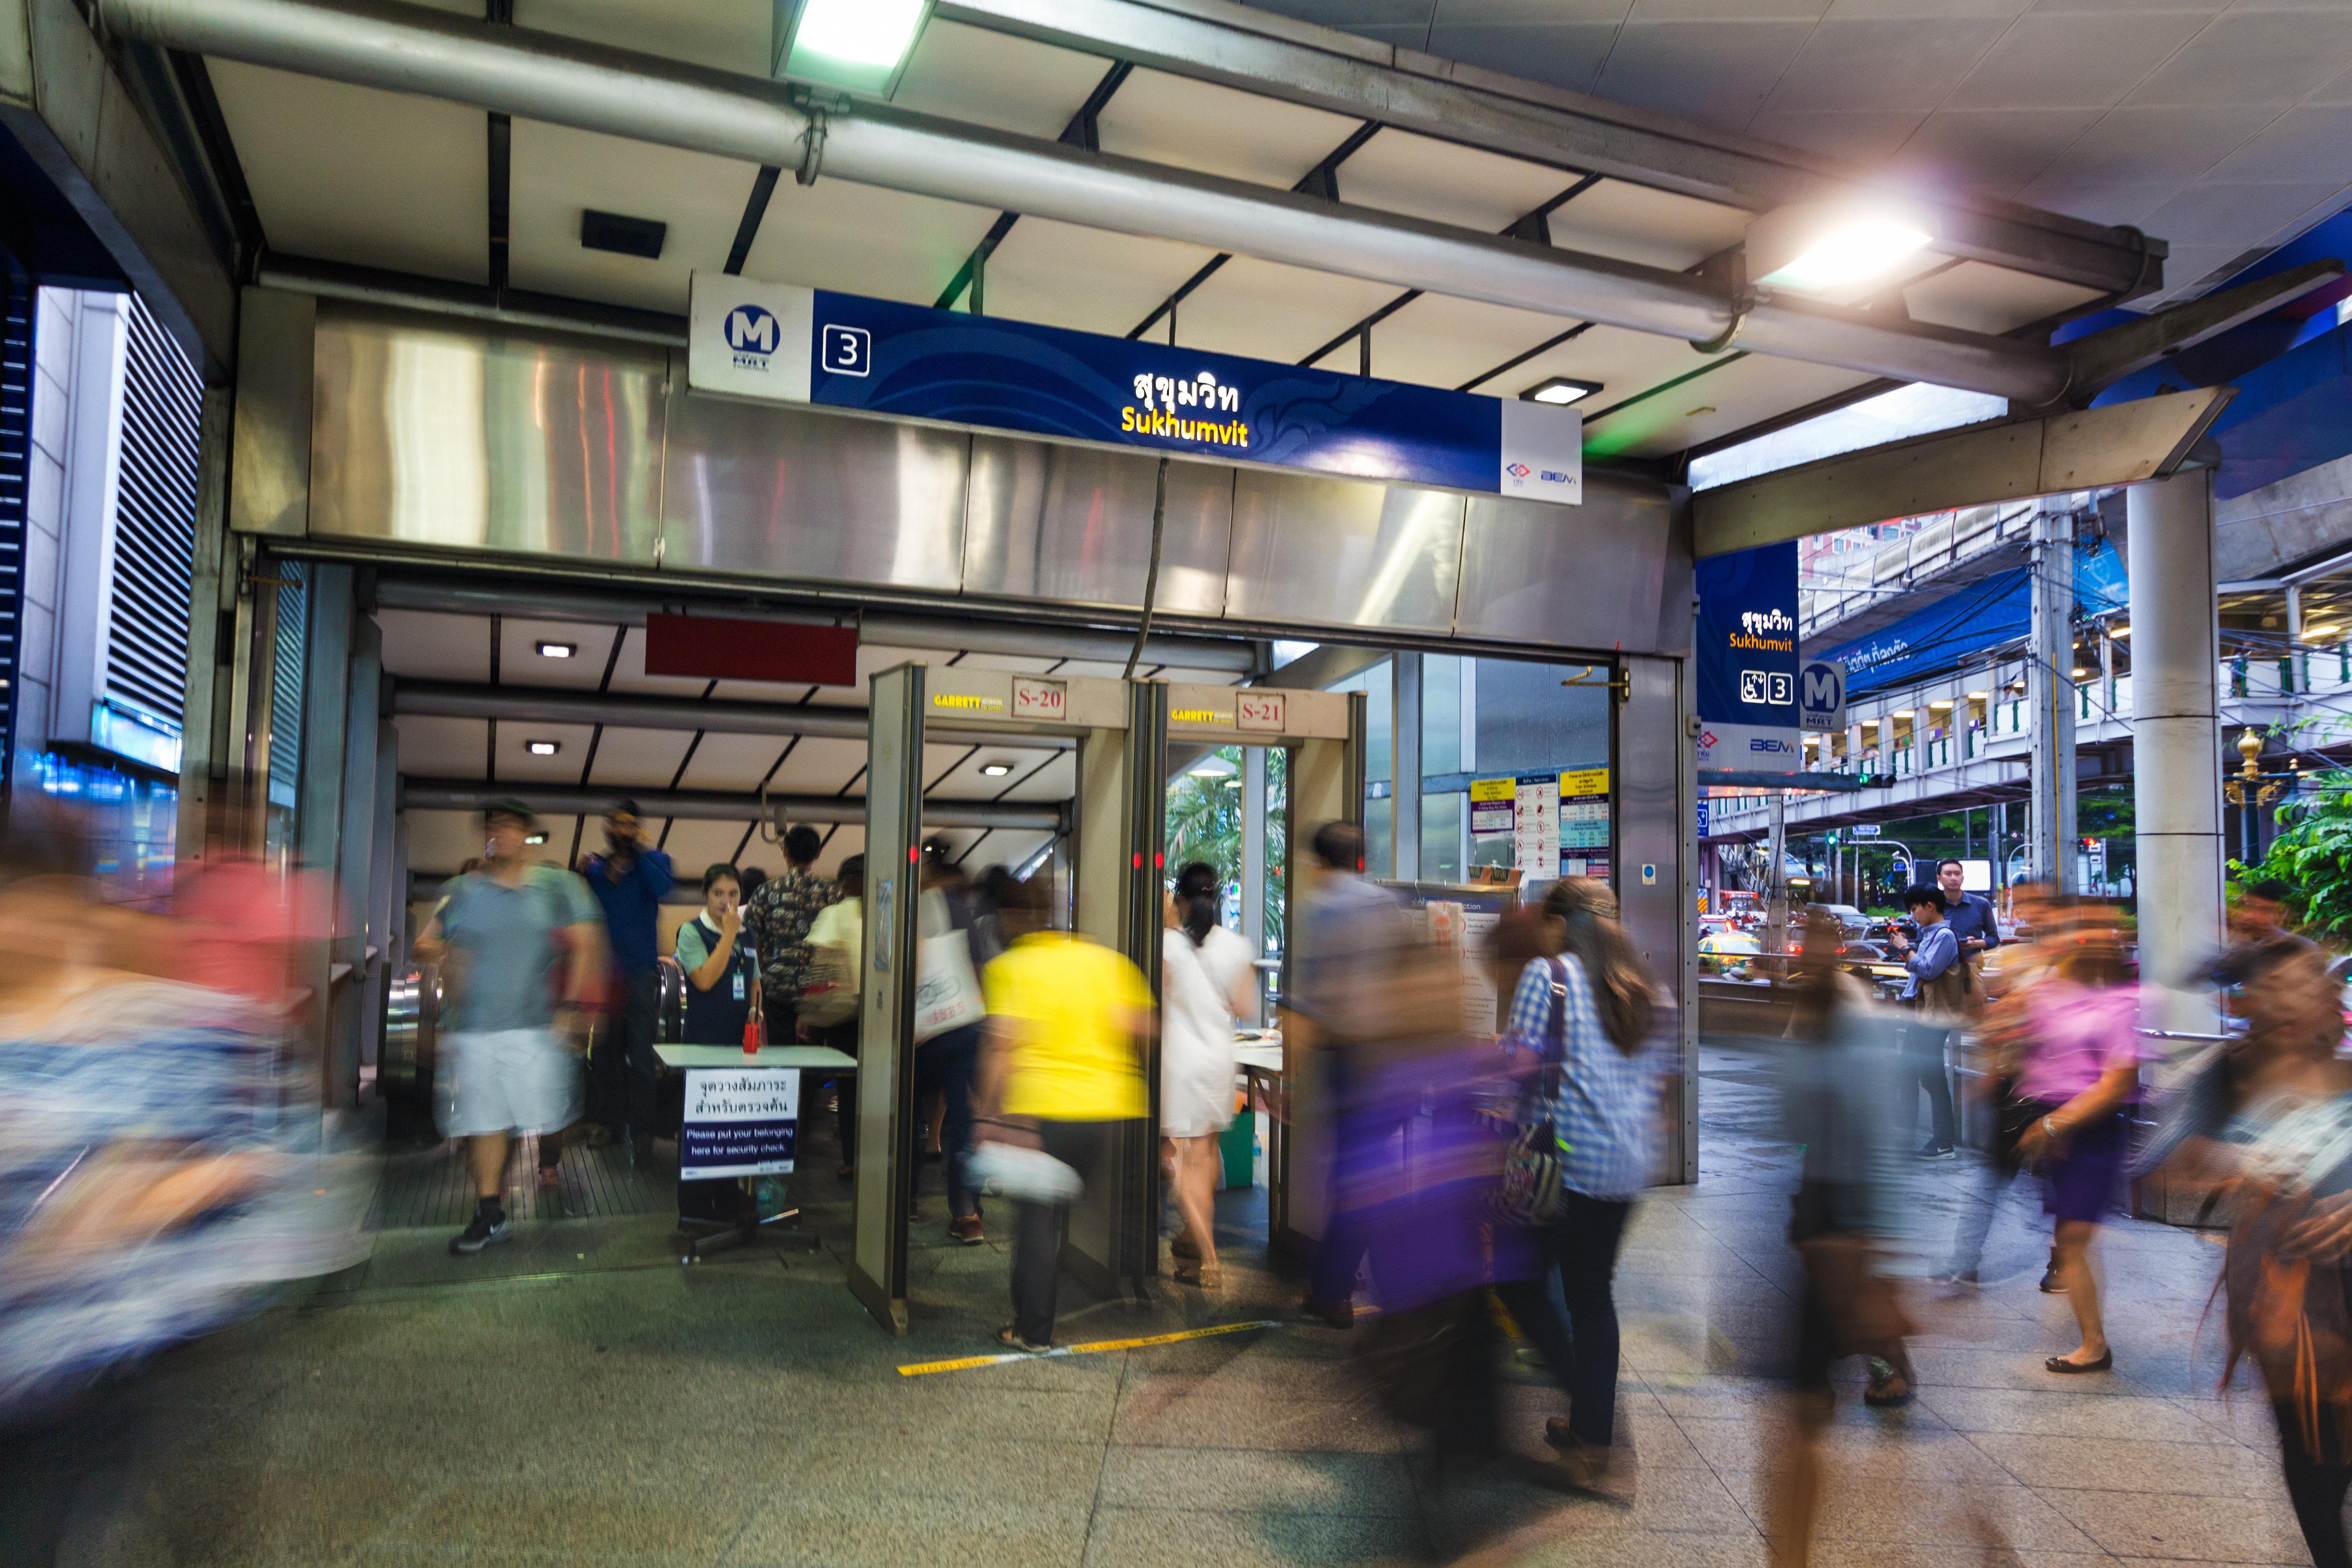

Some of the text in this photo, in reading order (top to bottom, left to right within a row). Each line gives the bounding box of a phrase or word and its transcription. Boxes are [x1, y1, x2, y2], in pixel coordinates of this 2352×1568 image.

[838, 334, 858, 365] 3
[1134, 372, 1238, 414] สุขุมวิท
[1122, 407, 1248, 447] Sukhumvit
[1741, 609, 1792, 634] สุขุมวิท
[1730, 633, 1792, 652] Sukhumvit
[1775, 679, 1785, 698] 3
[934, 694, 981, 709] GARRETT
[1019, 688, 1061, 709] S-20
[1171, 710, 1214, 722] GARRETT
[1243, 703, 1279, 721] S-21
[700, 1077, 786, 1098] จุดวางสัมภาระ
[696, 1097, 787, 1114] สำหรับตรวจค้น
[687, 1127, 793, 1141] Please put your belonging
[691, 1146, 710, 1155] here
[713, 1145, 724, 1155] for
[727, 1143, 758, 1155] security
